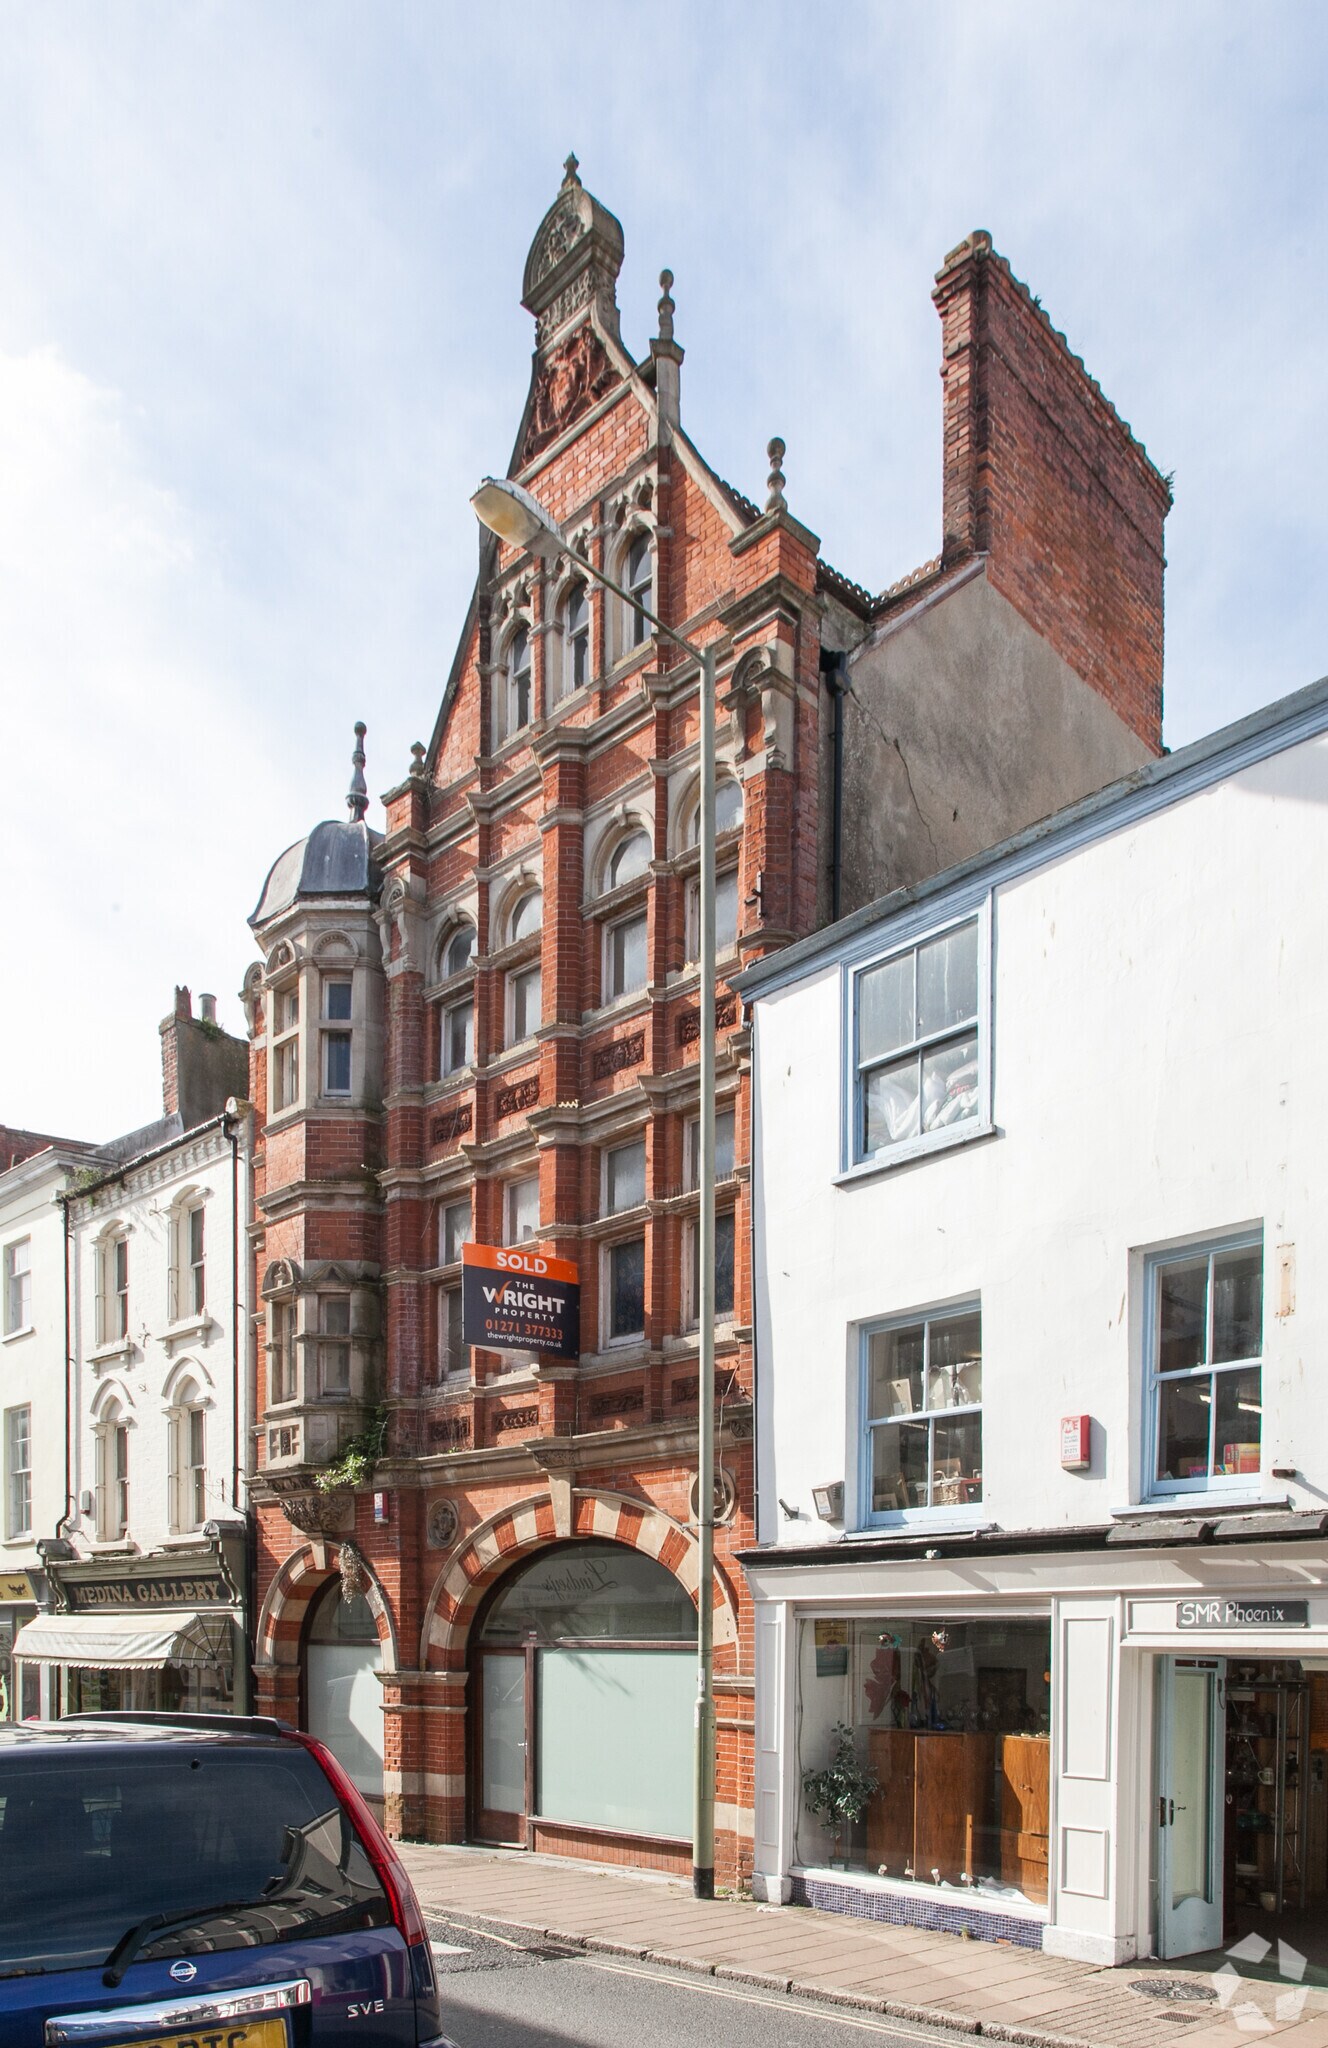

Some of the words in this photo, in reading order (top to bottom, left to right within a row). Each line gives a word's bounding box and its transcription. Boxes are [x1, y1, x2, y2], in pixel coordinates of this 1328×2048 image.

[496, 1251, 548, 1274] SOLD
[515, 1281, 535, 1290] THE
[482, 1282, 565, 1314] WRIGHT
[494, 1307, 555, 1322] PROPERTY
[485, 1319, 520, 1333] 01271
[525, 1323, 563, 1340] 377333
[487, 1331, 562, 1348] thewrightproperty.co.uk
[73, 1584, 135, 1604] MEDINA
[137, 1580, 220, 1602] GALLERY
[1180, 1601, 1222, 1625] SMR
[1225, 1601, 1285, 1623] Phoenix
[347, 1999, 385, 2018] SVE
